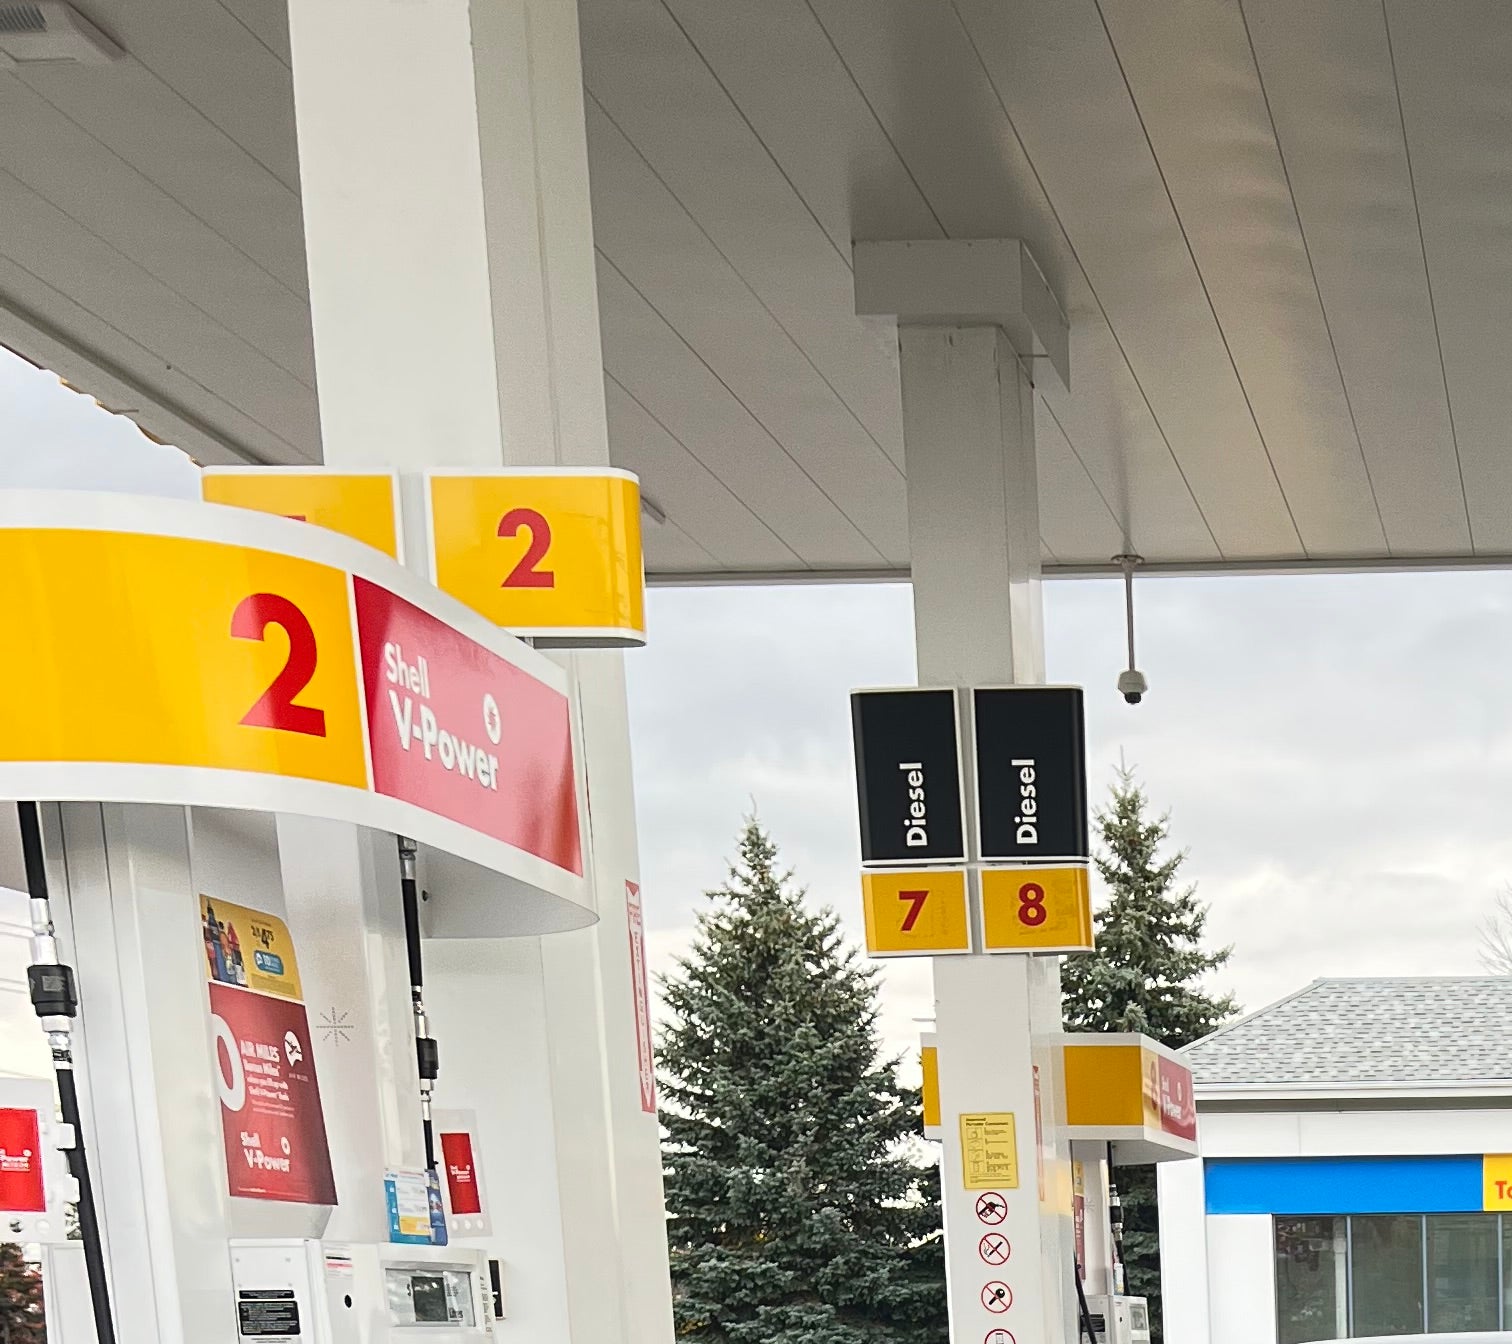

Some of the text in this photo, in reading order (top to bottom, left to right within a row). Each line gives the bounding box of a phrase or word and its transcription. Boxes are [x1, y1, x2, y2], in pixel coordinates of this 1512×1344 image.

[498, 509, 555, 588] 2
[230, 592, 326, 737] 2
[384, 642, 430, 699] Shell
[388, 689, 499, 791] V-Power
[900, 762, 928, 847] Diesel
[1012, 759, 1038, 844] Diesel
[899, 890, 929, 932] 7
[1018, 882, 1047, 927] 8
[243, 1148, 291, 1173] V-Power
